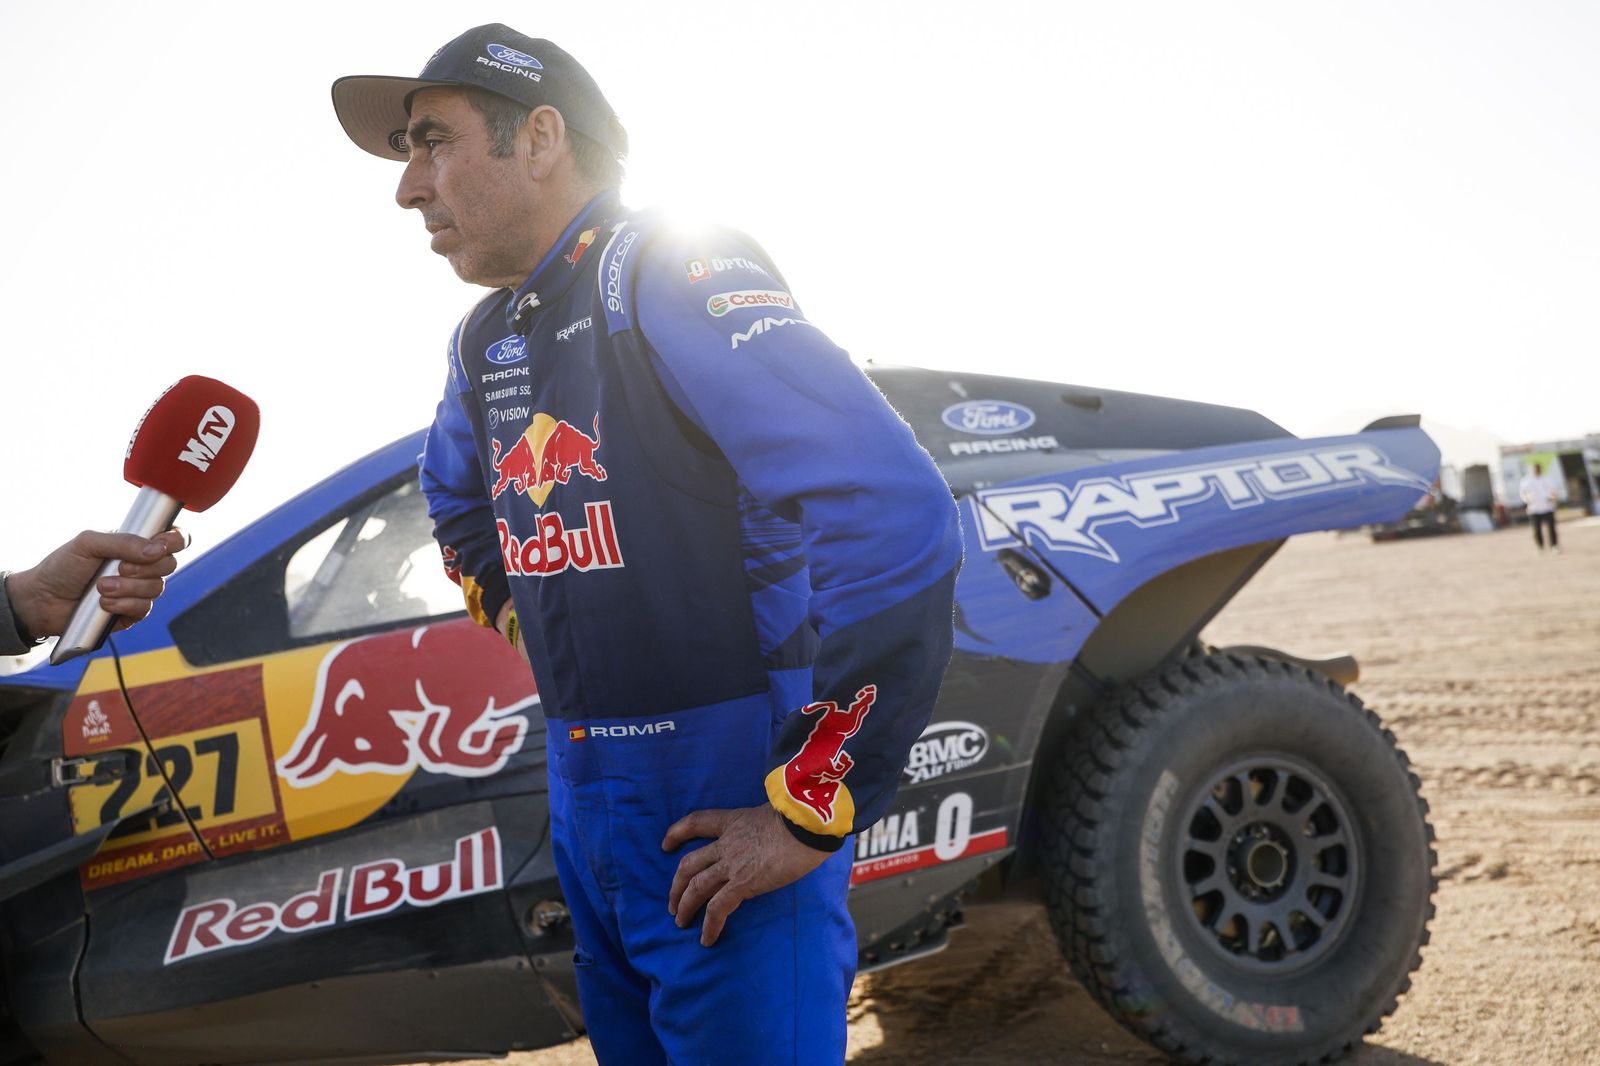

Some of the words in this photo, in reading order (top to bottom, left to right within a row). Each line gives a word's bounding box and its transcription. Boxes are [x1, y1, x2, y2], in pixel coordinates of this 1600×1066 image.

[476, 56, 542, 82] RACING
[497, 49, 534, 65] Ford
[607, 231, 639, 314] sparco
[712, 257, 771, 278] OPTIM
[556, 317, 592, 341] RAPTO
[731, 317, 811, 350] MM
[497, 338, 526, 361] Ford
[485, 386, 518, 402] SAMSUNG
[500, 406, 530, 423] VISION
[962, 405, 1019, 430] Ford
[949, 435, 1059, 456] RACING
[972, 444, 1434, 563] RAPTOR
[496, 512, 548, 577] Red
[541, 500, 625, 577] Bull
[590, 720, 676, 738] ROMA
[908, 731, 980, 768] BMC
[94, 732, 239, 841] 227
[88, 852, 158, 879] DREAM.
[219, 828, 257, 848] LIVE
[163, 867, 344, 966] Red
[344, 825, 504, 922] Bull
